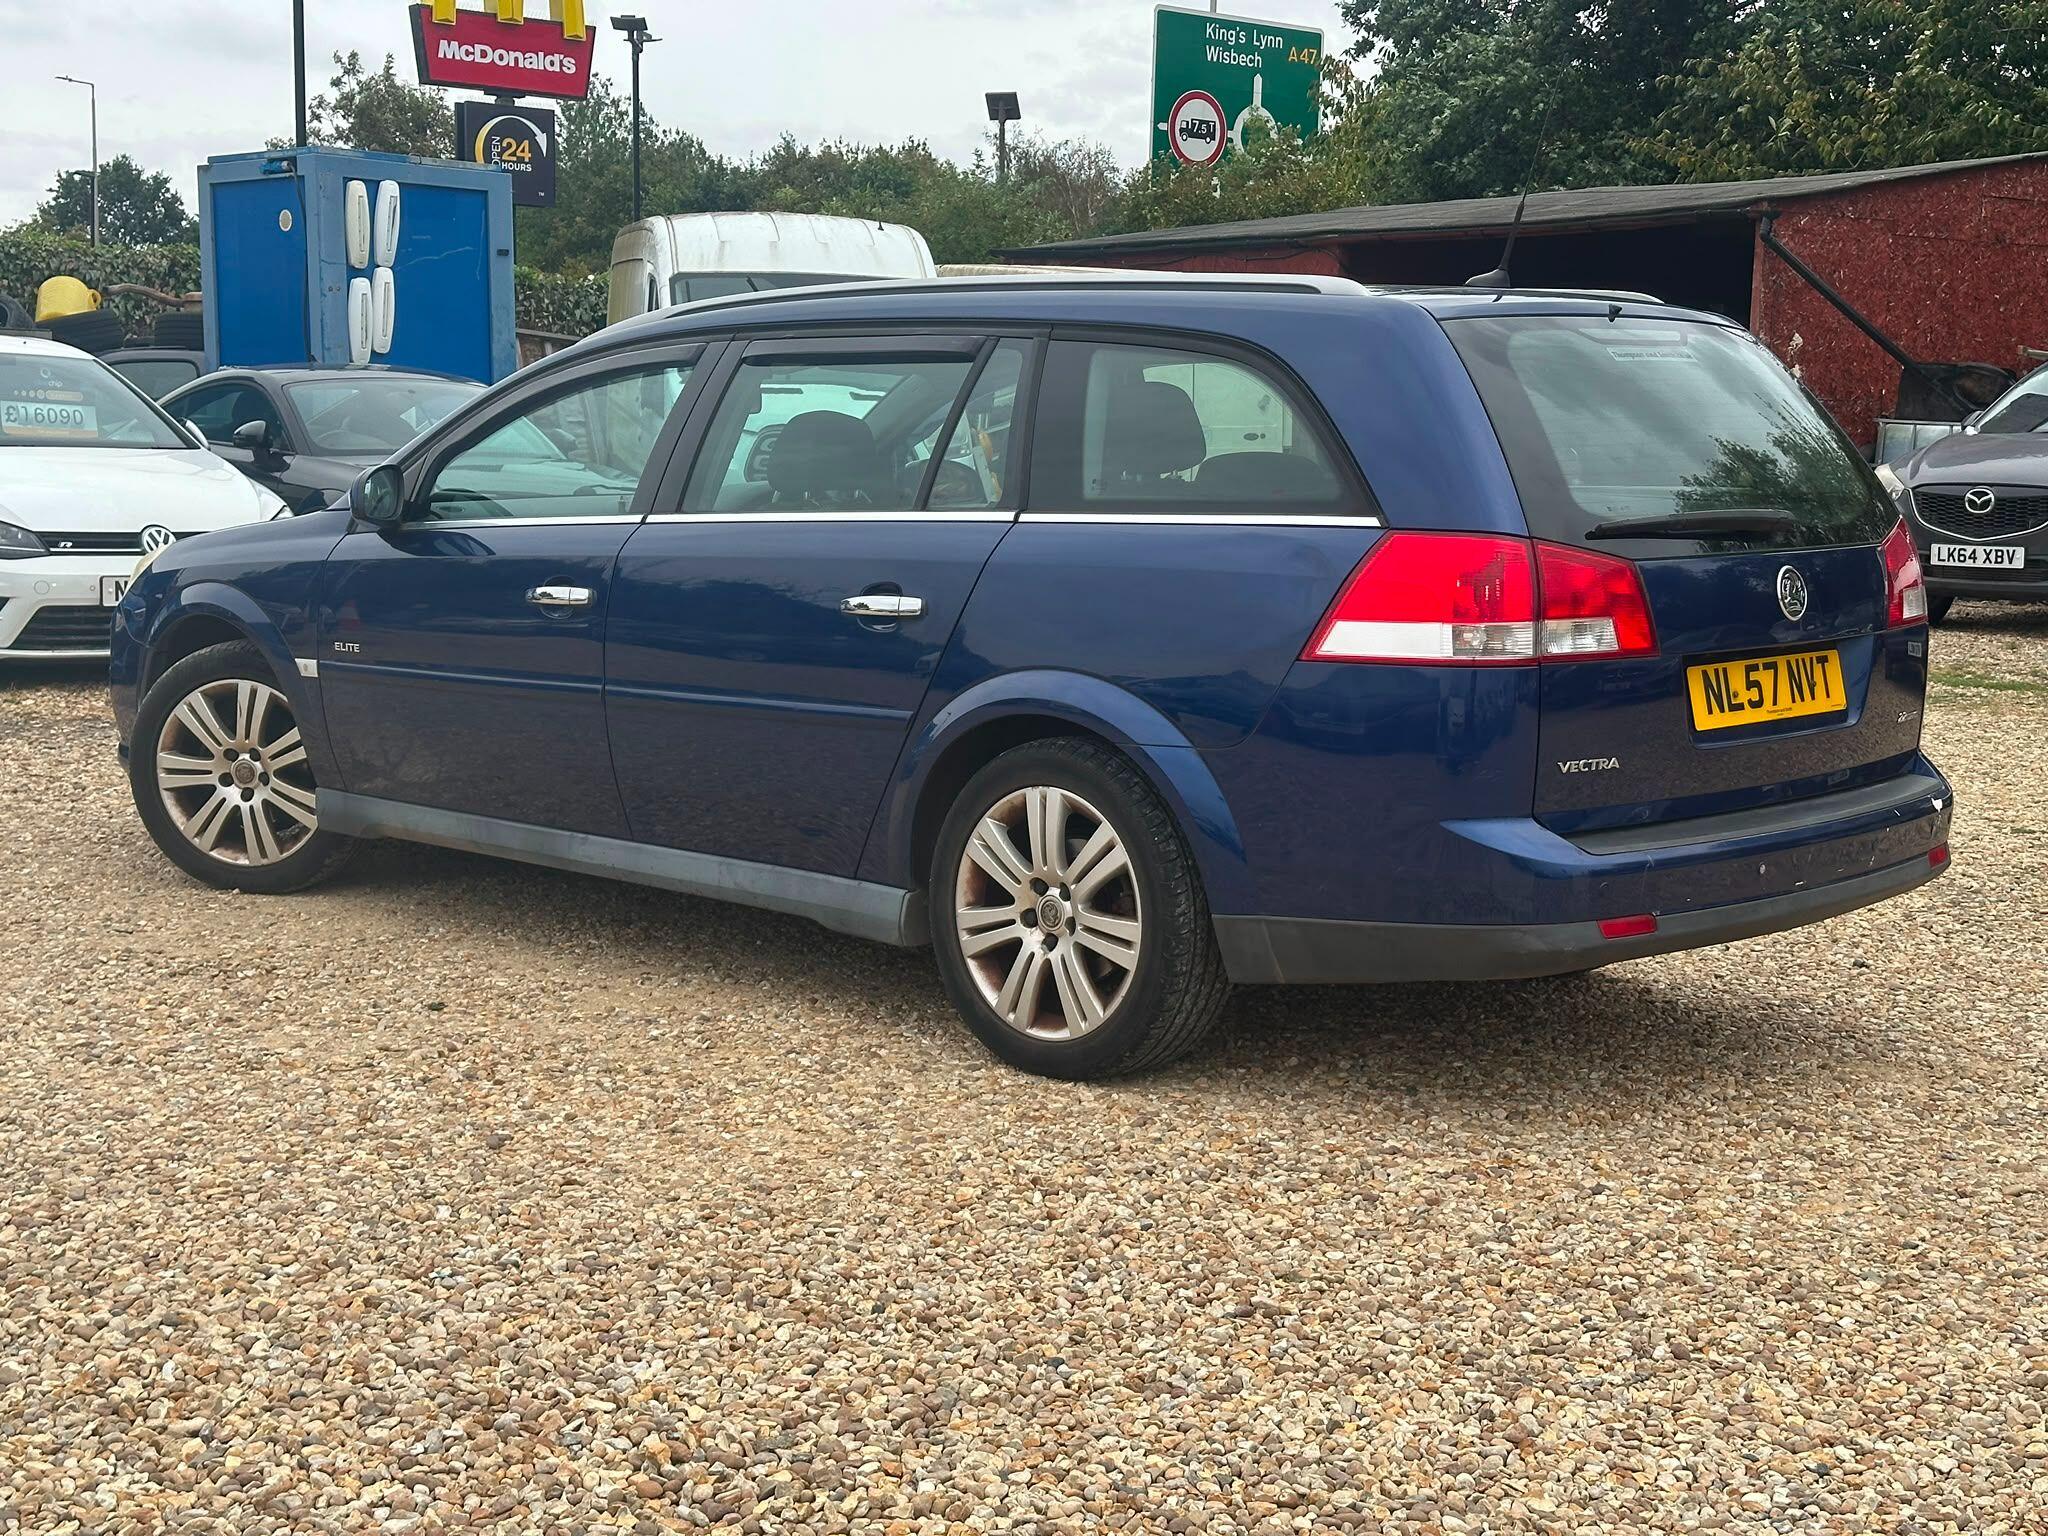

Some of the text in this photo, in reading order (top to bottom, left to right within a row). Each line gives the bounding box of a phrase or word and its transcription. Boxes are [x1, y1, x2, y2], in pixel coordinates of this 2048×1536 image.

[1206, 22, 1283, 50] King's Lynn
[438, 39, 577, 75] McDonald's
[1206, 45, 1263, 68] Wisbech
[1288, 46, 1318, 65] A47
[501, 137, 532, 162] 24
[501, 161, 532, 172] HOURS
[1937, 546, 2016, 565] LK64 XBV
[334, 641, 360, 653] ELITE
[1701, 655, 1831, 715] NL57 NVT
[1557, 757, 1620, 774] VECTRA
